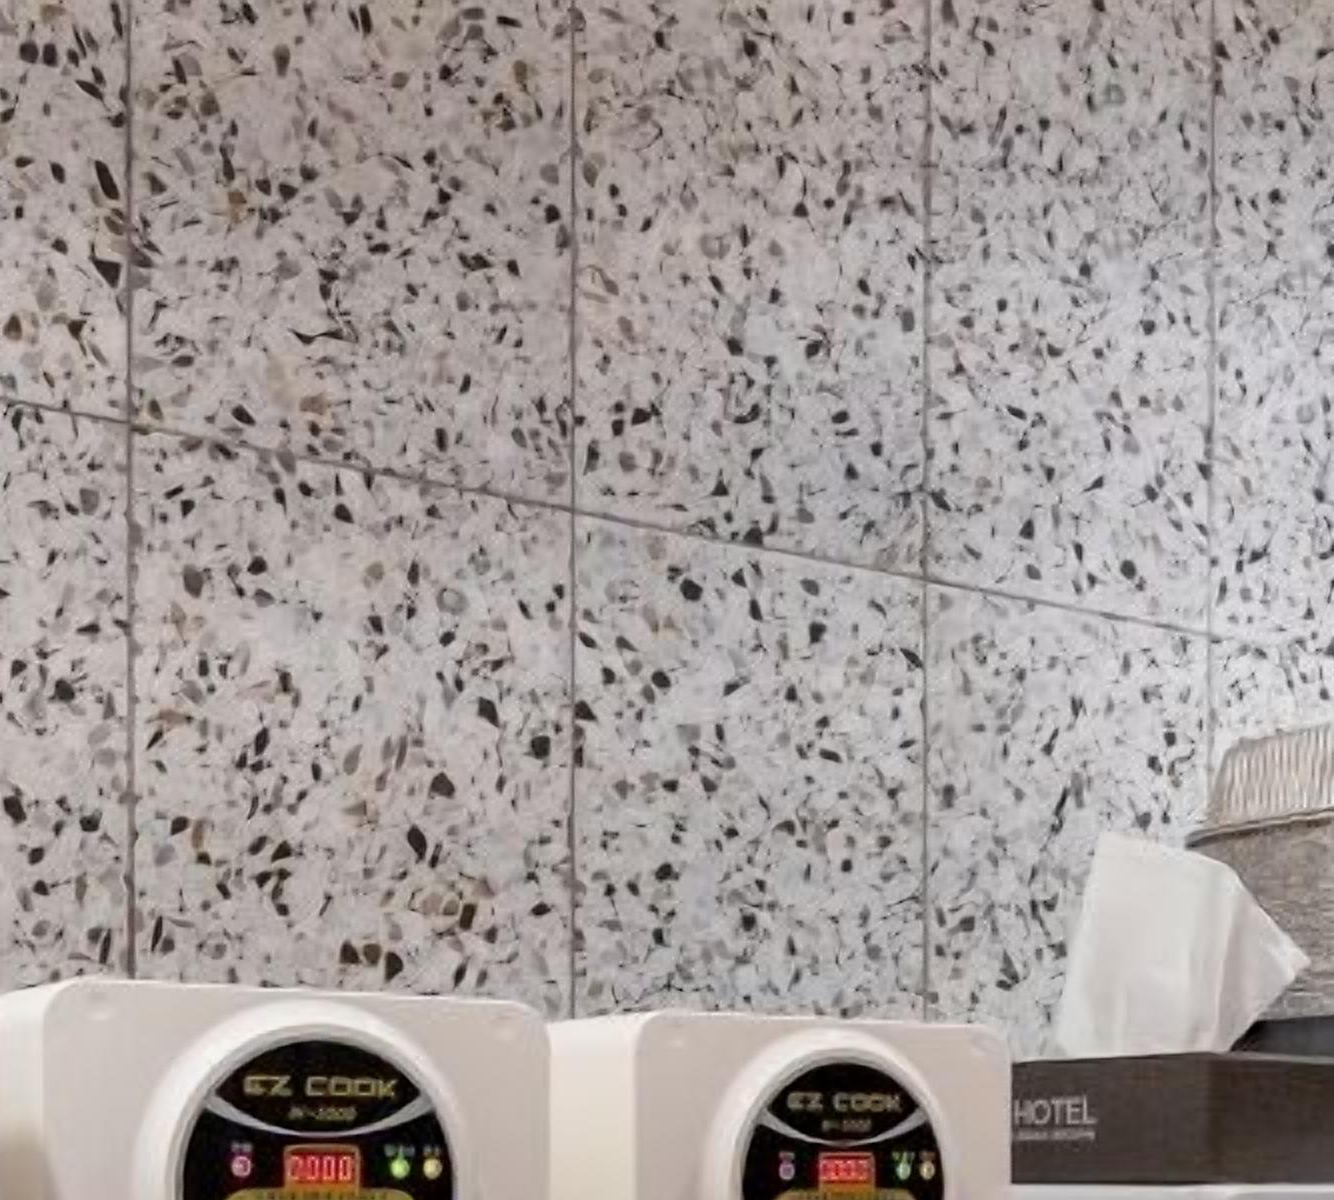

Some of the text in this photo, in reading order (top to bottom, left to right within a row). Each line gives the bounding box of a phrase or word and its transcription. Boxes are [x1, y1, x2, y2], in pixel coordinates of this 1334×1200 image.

[243, 1074, 399, 1098] EZ COOK
[1014, 1095, 1098, 1126] HOTEL
